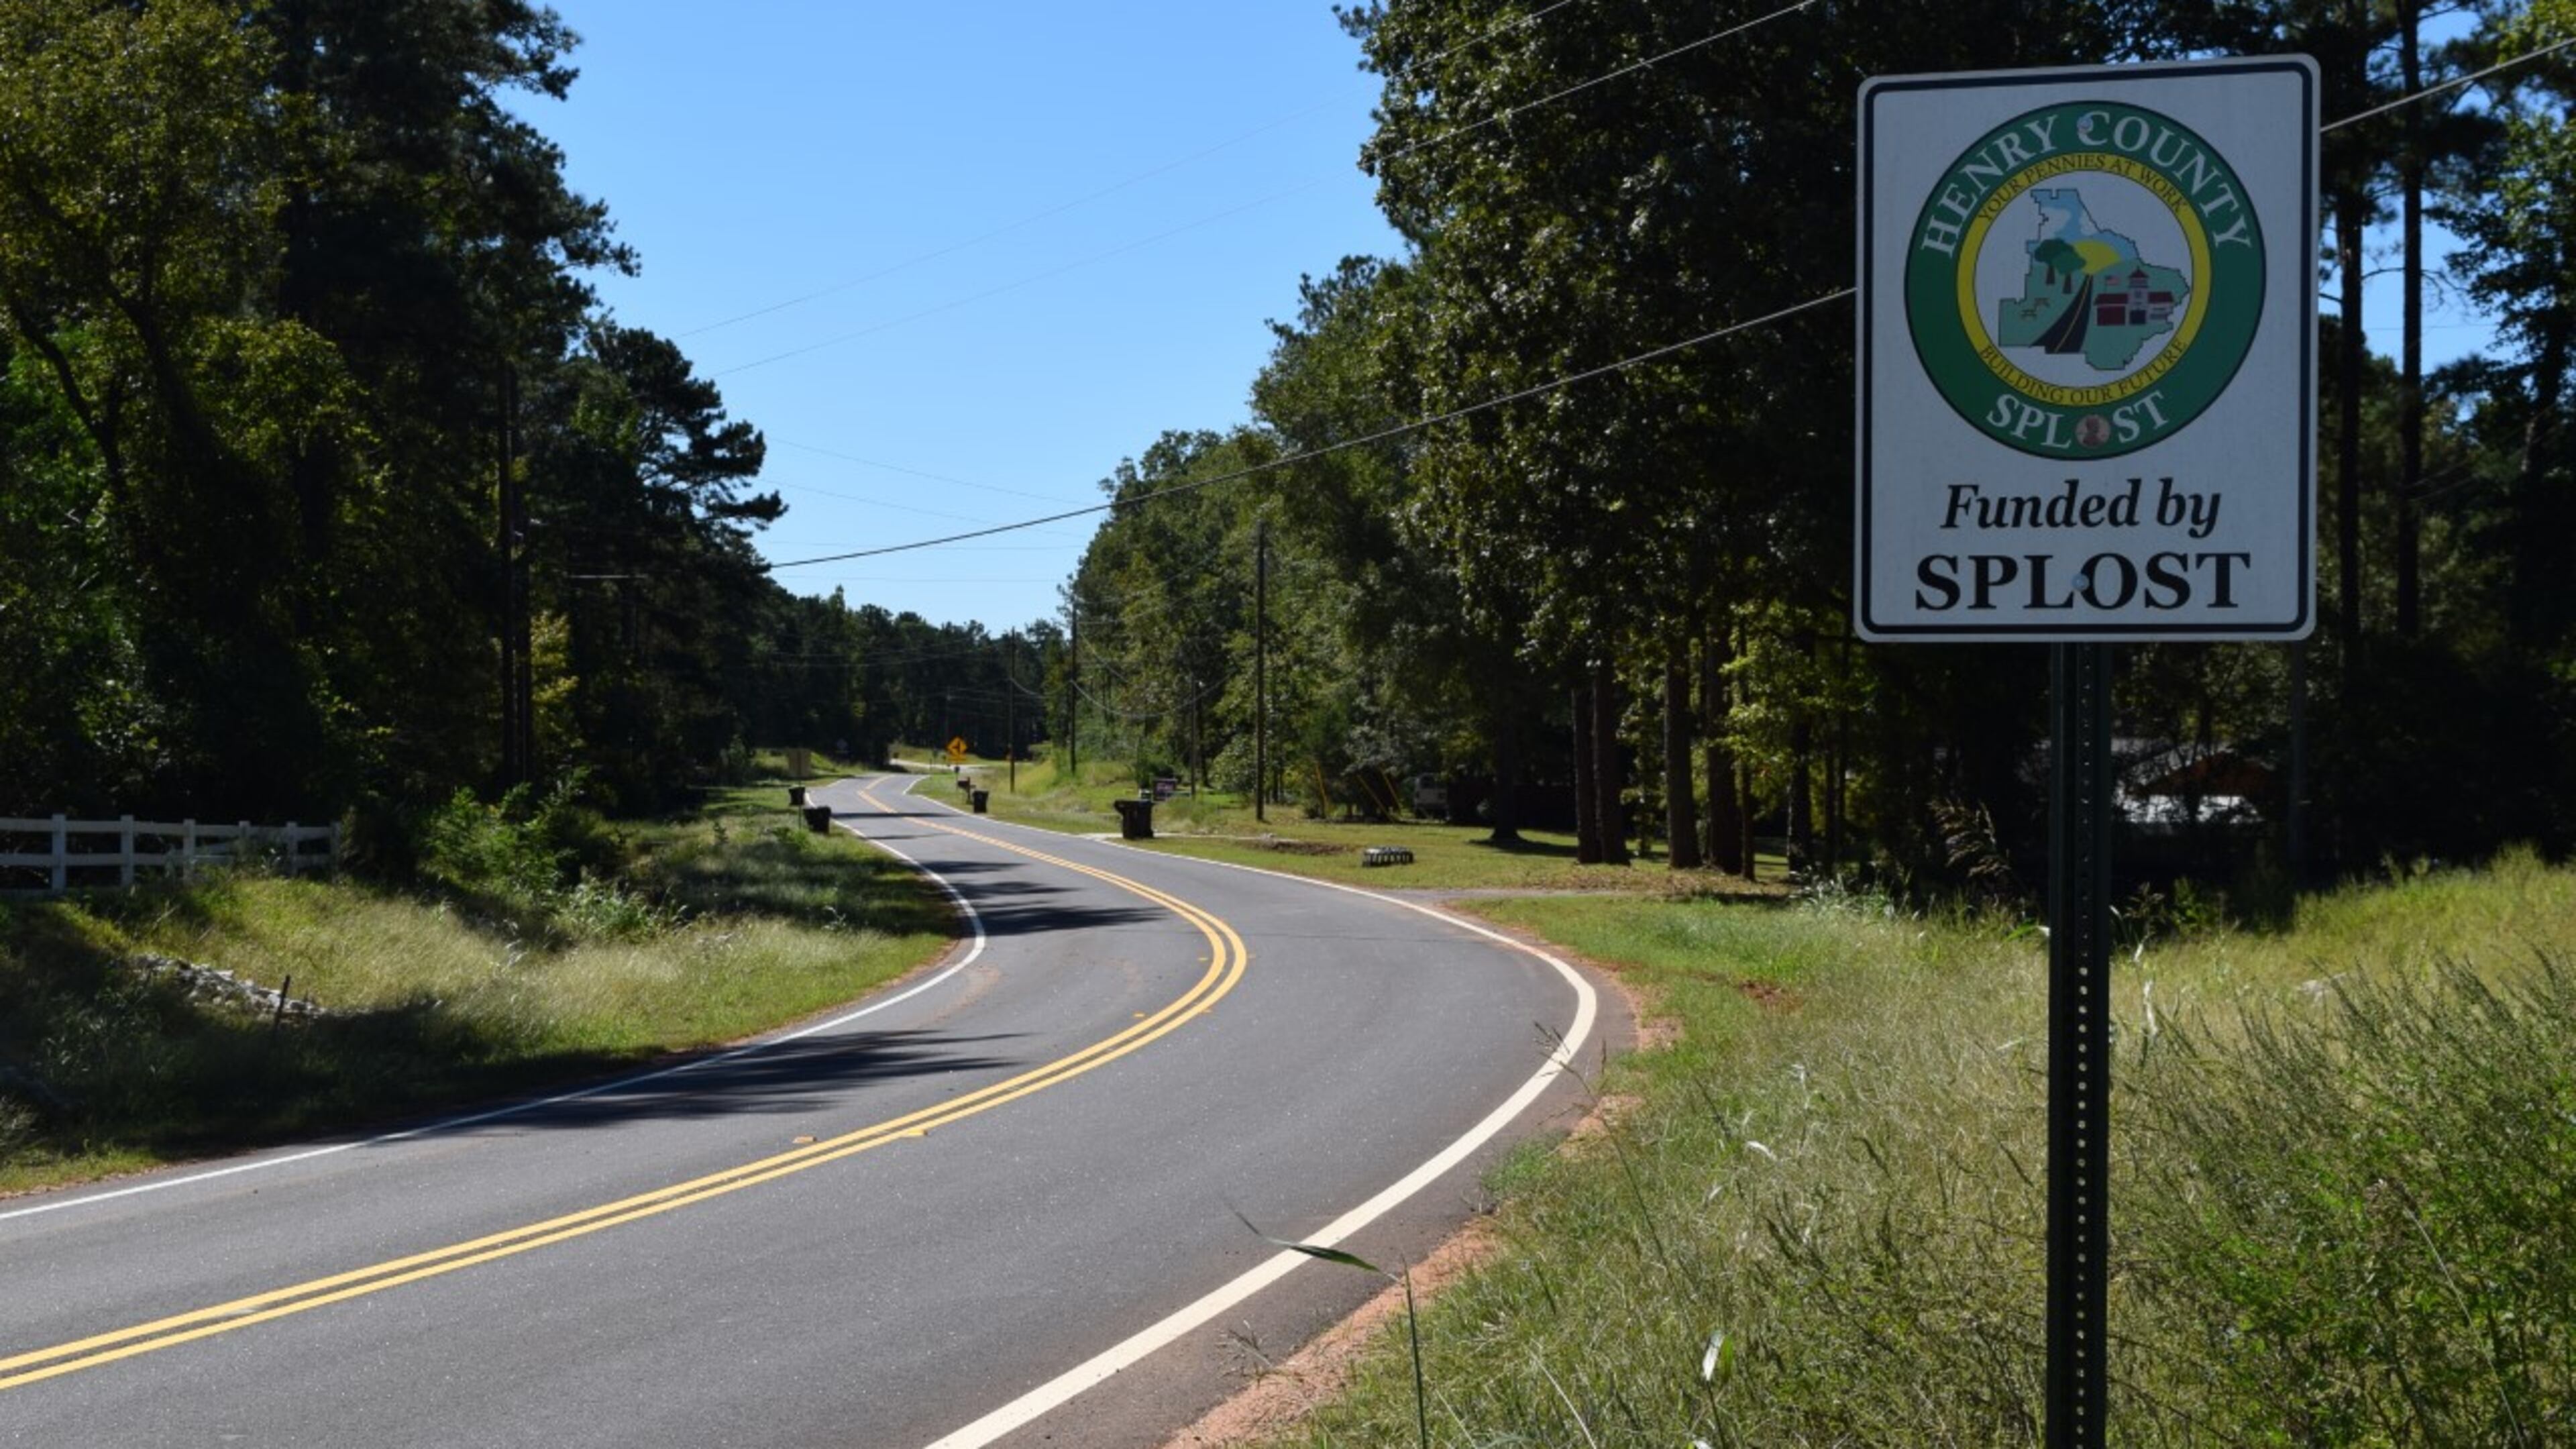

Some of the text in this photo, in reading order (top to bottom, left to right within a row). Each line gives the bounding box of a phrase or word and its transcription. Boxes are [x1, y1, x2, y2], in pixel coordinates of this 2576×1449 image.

[1921, 110, 2251, 258] HENRY COUNTY
[1978, 154, 2188, 222] YOUR PENNIES AT WORK
[1980, 341, 2186, 403] BUILDING OUR FUTURE
[1939, 477, 2222, 538] Funded by
[1915, 551, 2251, 610] SPLOST
